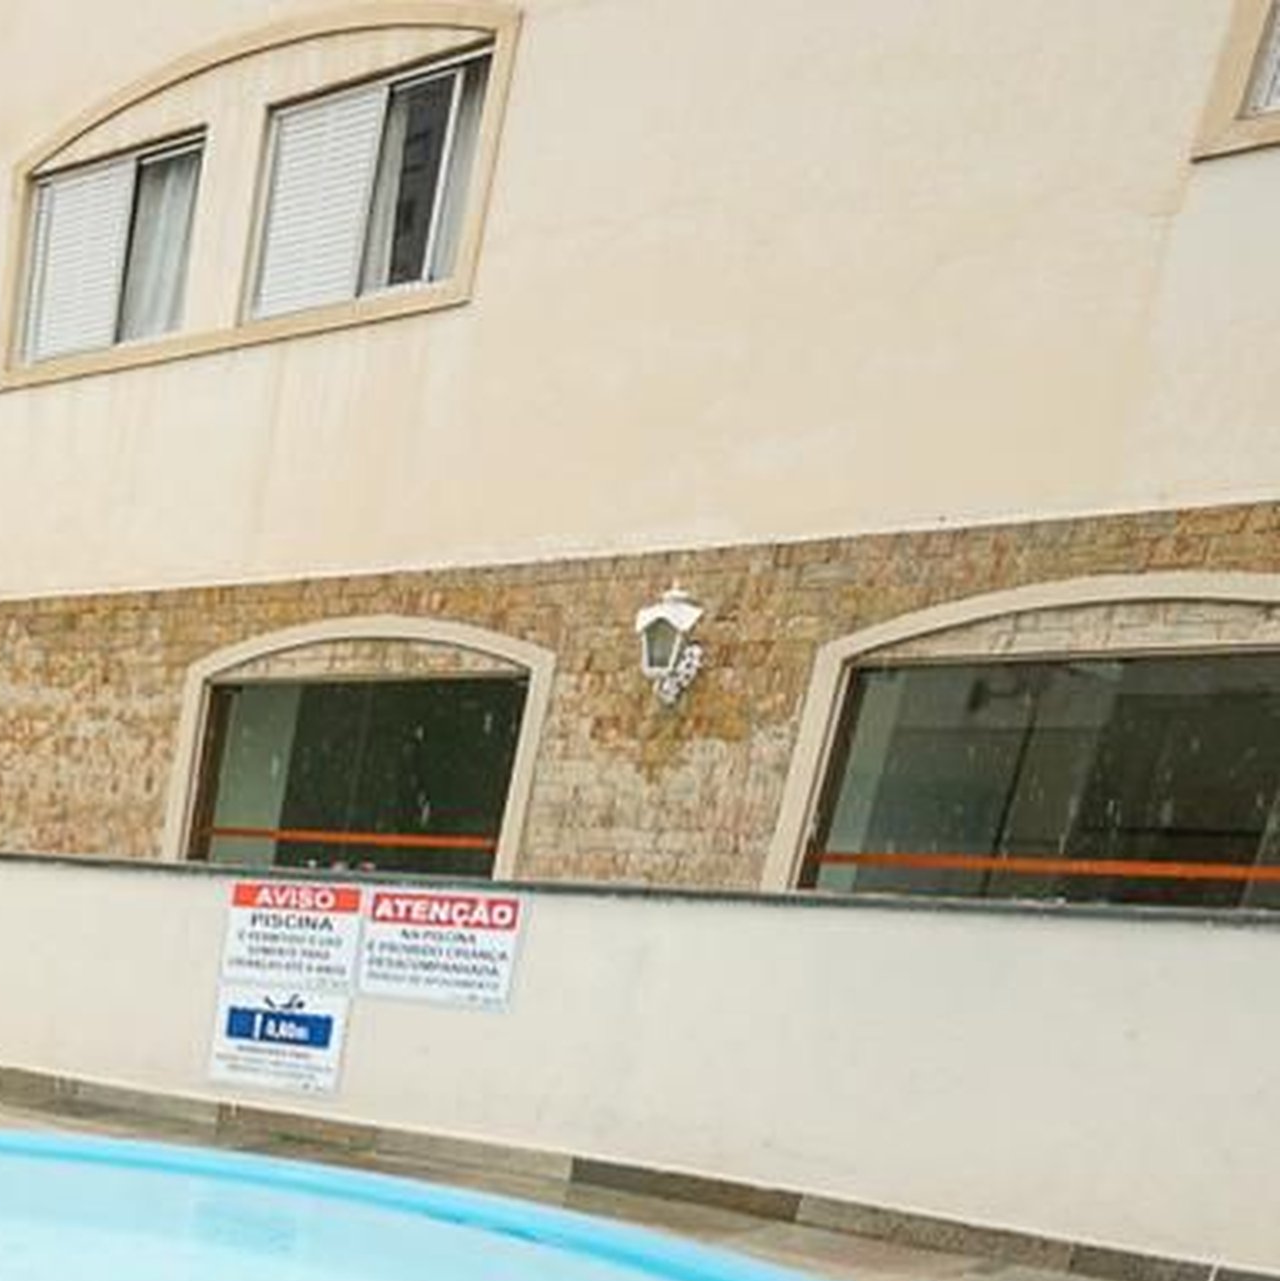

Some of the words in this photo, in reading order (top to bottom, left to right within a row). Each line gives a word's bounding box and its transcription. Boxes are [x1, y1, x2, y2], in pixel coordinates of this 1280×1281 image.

[255, 885, 336, 909] AVISO
[251, 912, 334, 931] PISCINA
[375, 896, 515, 927] ATENÇÃO
